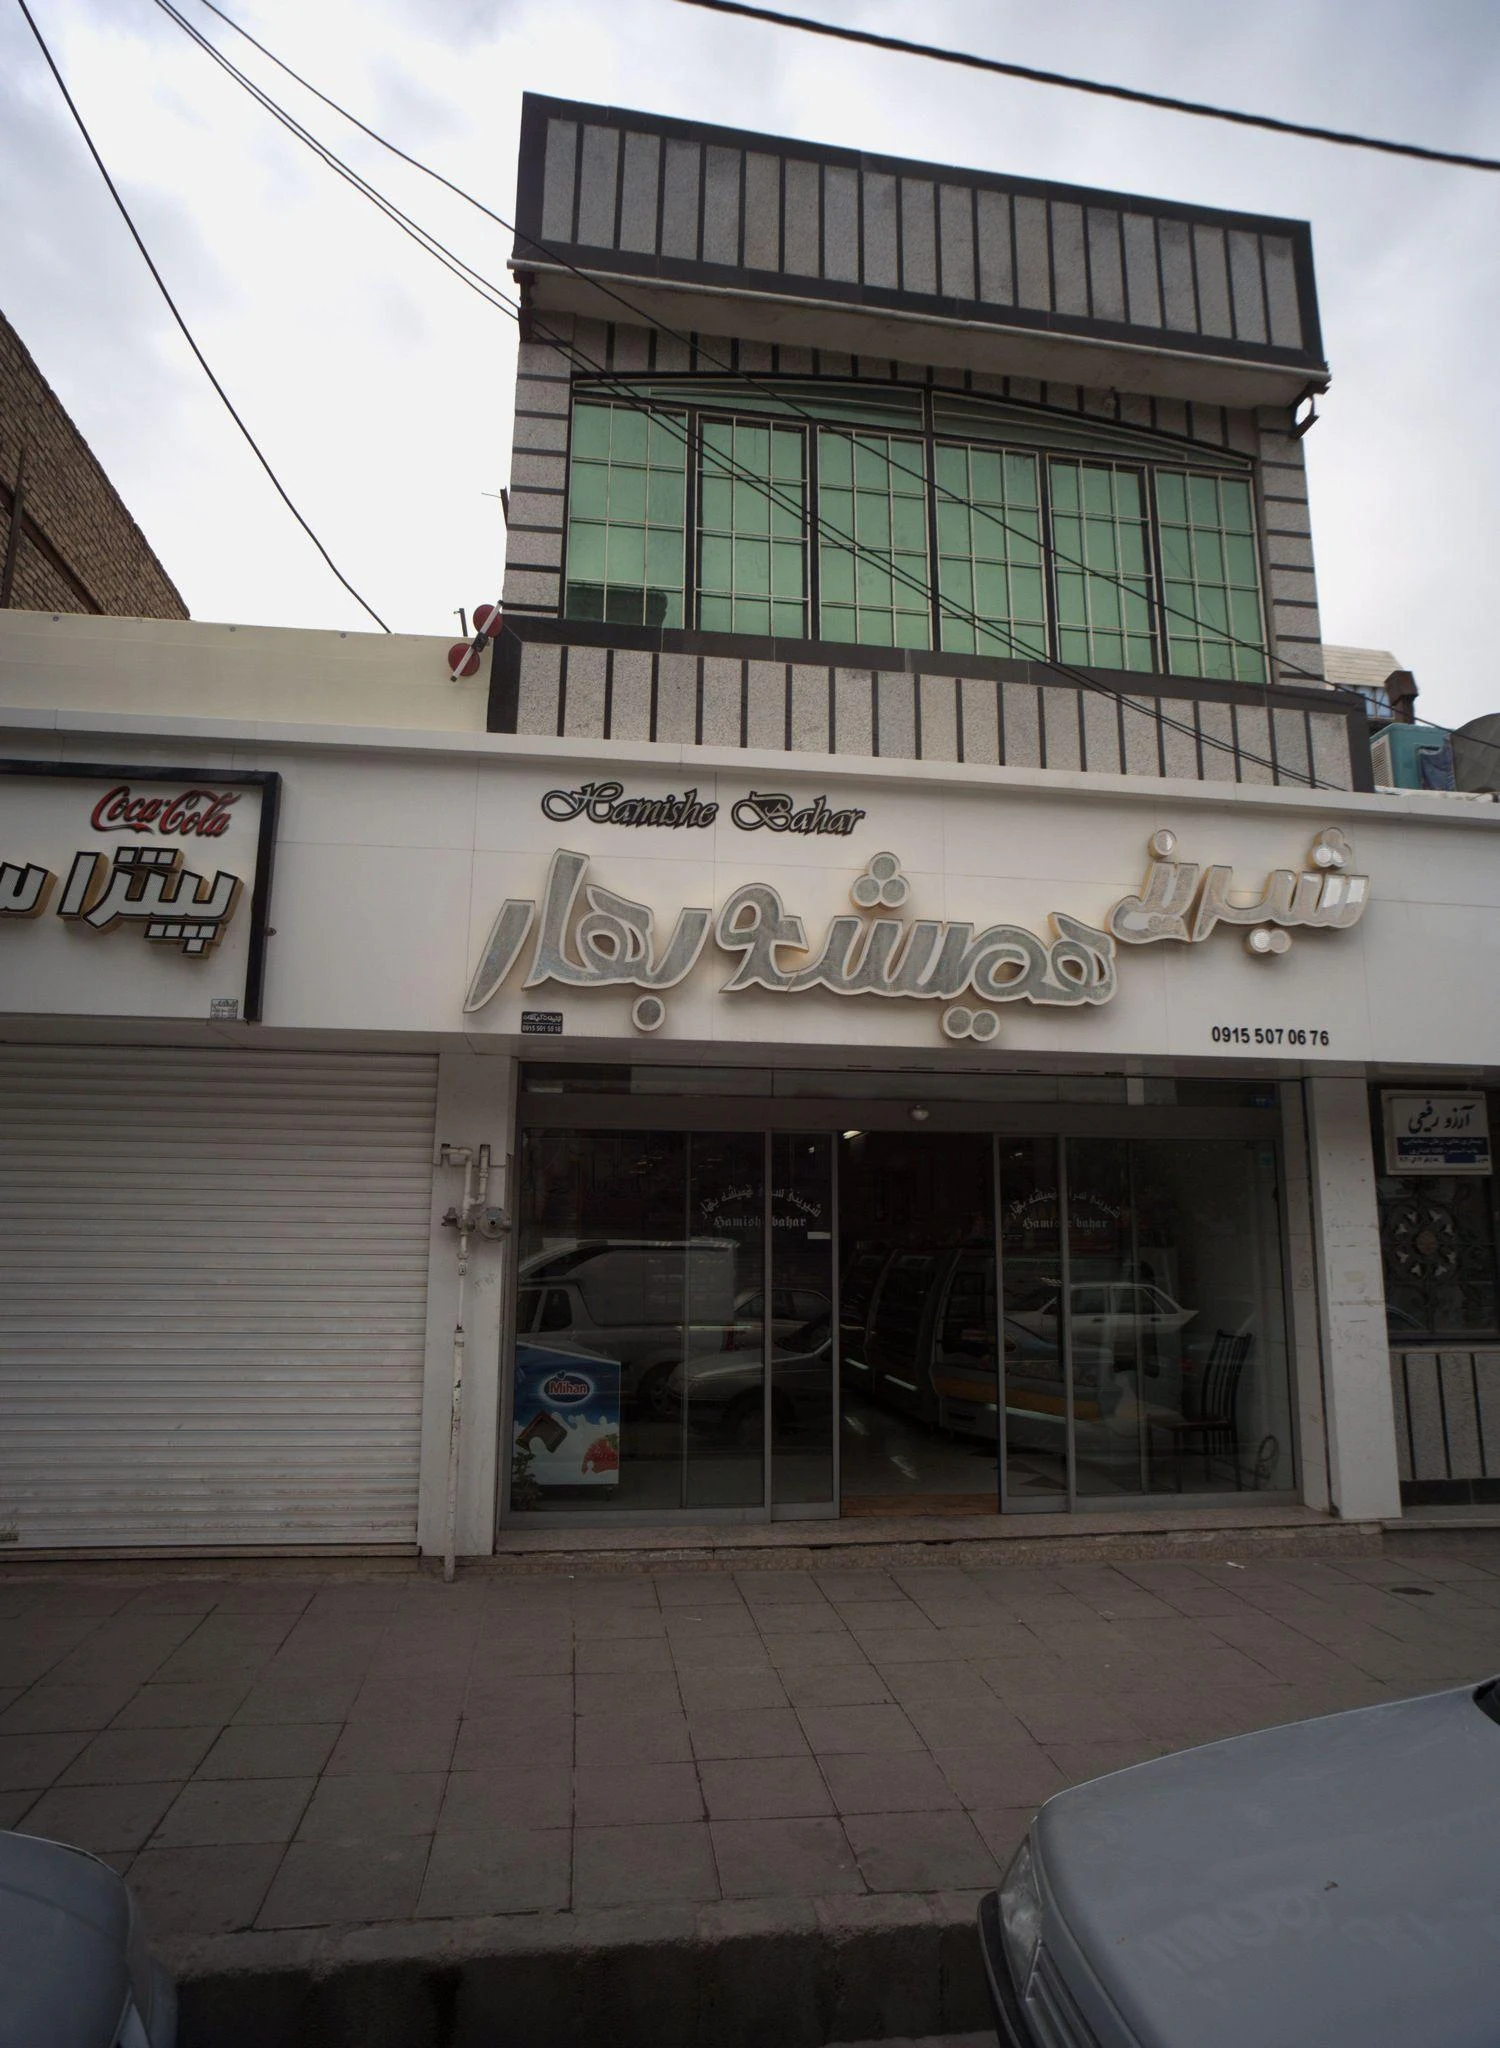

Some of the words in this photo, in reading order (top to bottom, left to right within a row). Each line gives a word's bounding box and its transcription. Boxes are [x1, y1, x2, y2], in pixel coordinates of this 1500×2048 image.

[541, 782, 719, 830] Hamishe
[731, 791, 866, 836] Bahar
[57, 846, 241, 956] پیتزا
[463, 848, 712, 1032] بهار
[714, 851, 1118, 1042] همیشه
[549, 1380, 588, 1395] Mihan
